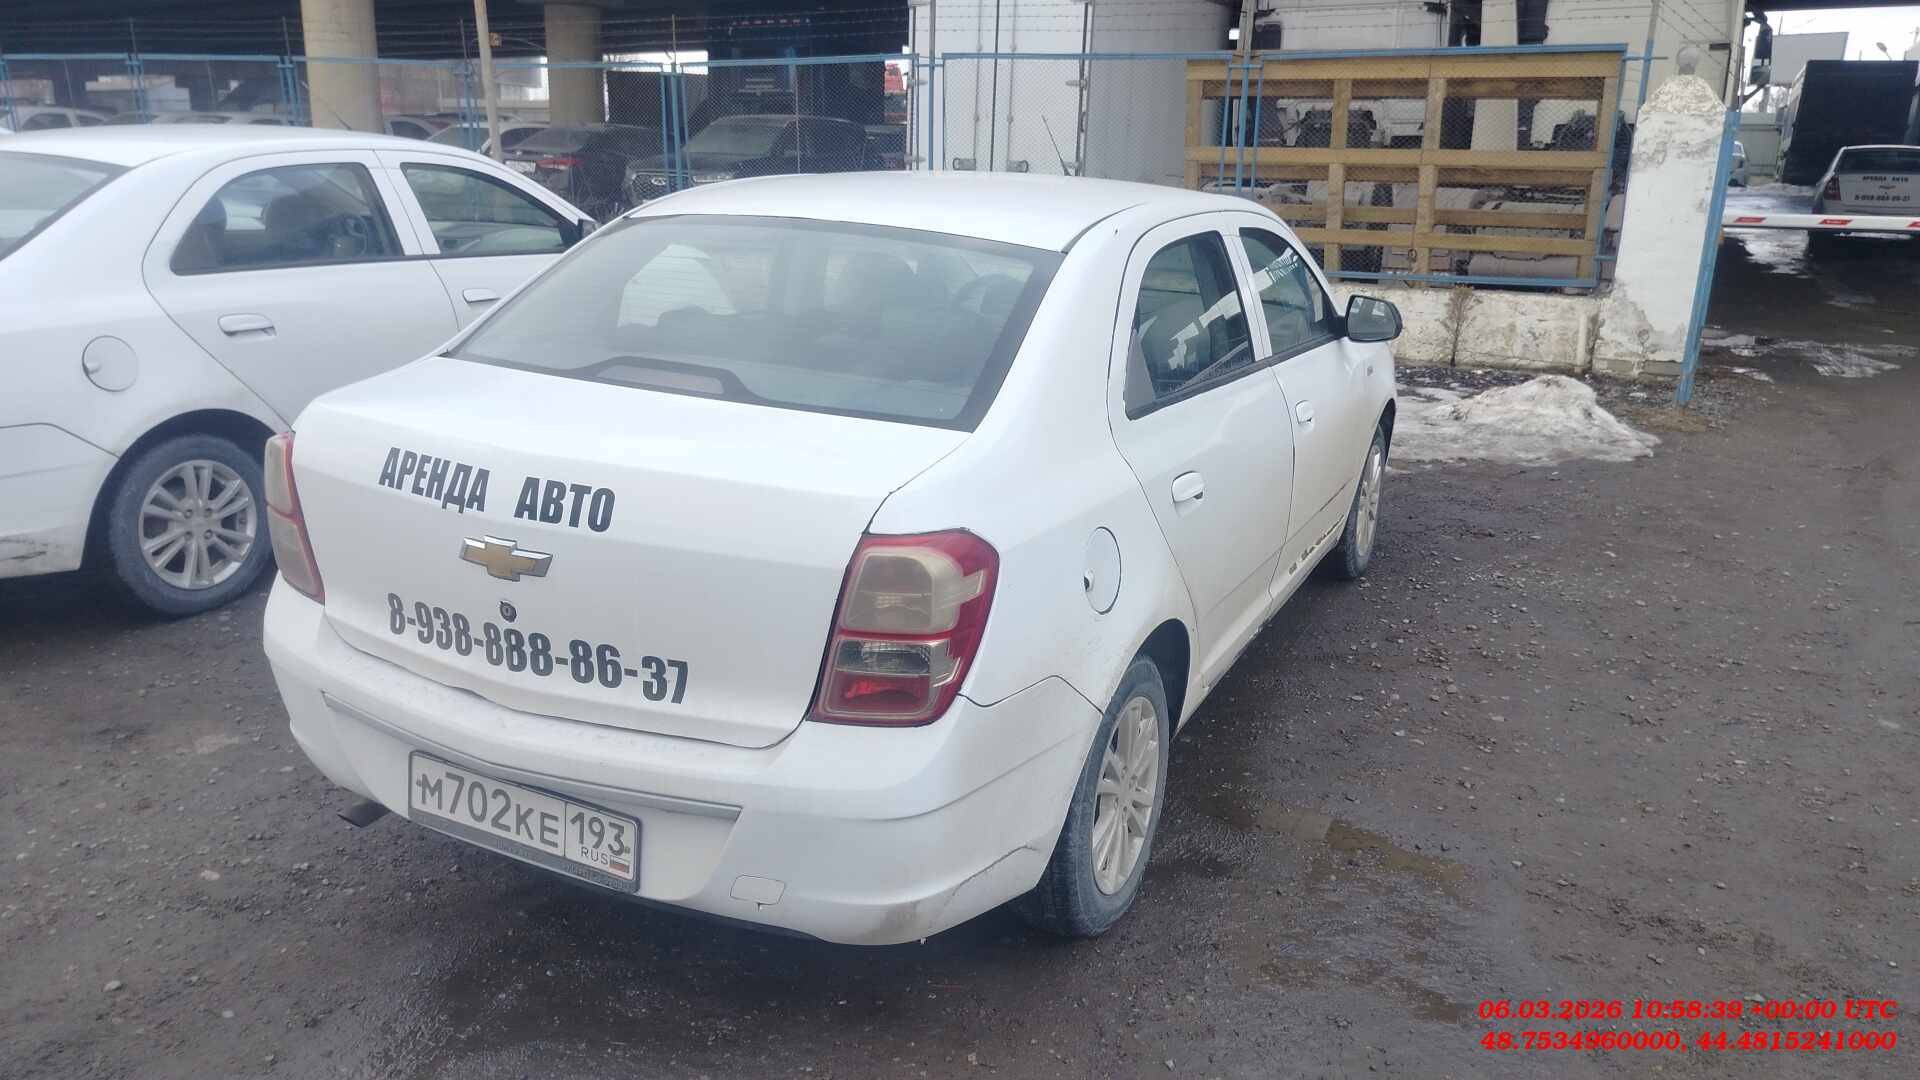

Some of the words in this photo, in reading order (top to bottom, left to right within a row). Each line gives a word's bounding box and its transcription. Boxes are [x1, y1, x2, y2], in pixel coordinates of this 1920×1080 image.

[378, 446, 491, 514] АРЕНДА
[513, 476, 616, 533] АВТО
[387, 592, 689, 705] 8-938-888-86-37
[421, 773, 559, 849] М702КЕ
[570, 811, 626, 856] 193
[580, 846, 609, 865] RUS
